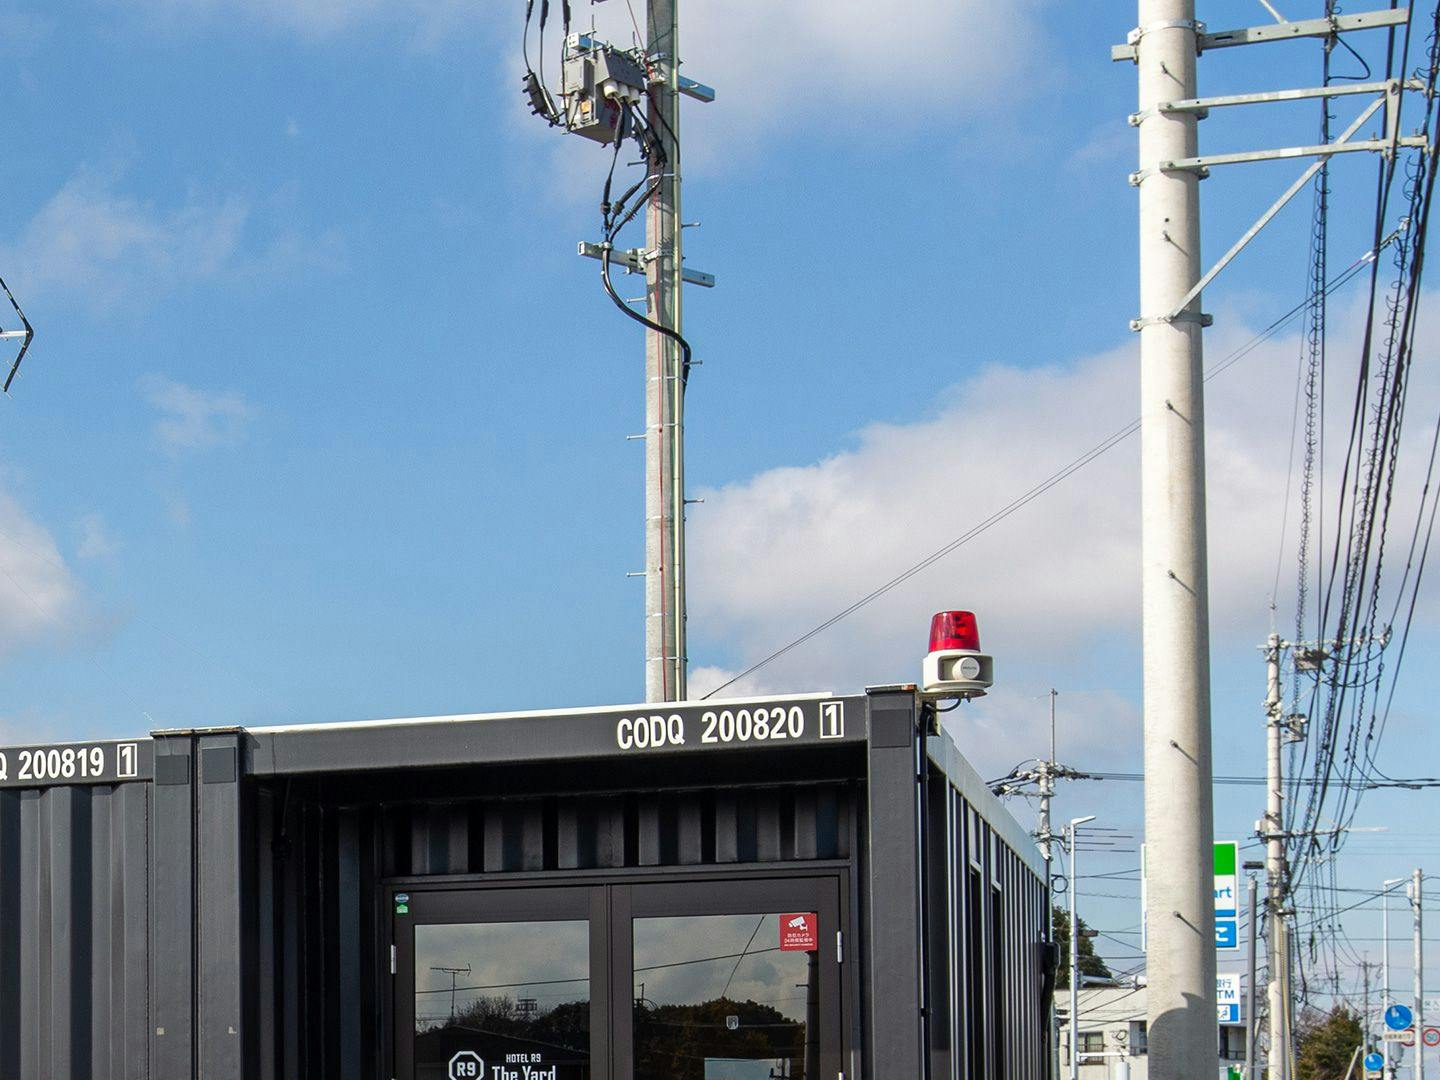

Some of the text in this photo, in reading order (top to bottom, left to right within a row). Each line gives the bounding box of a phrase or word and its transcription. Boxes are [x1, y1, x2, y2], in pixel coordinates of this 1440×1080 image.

[617, 702, 841, 750] CODQ 200820 1
[18, 747, 104, 780] 200819
[120, 745, 135, 776] 1
[456, 1062, 476, 1077] R9
[506, 1053, 541, 1063] HOTEL R9
